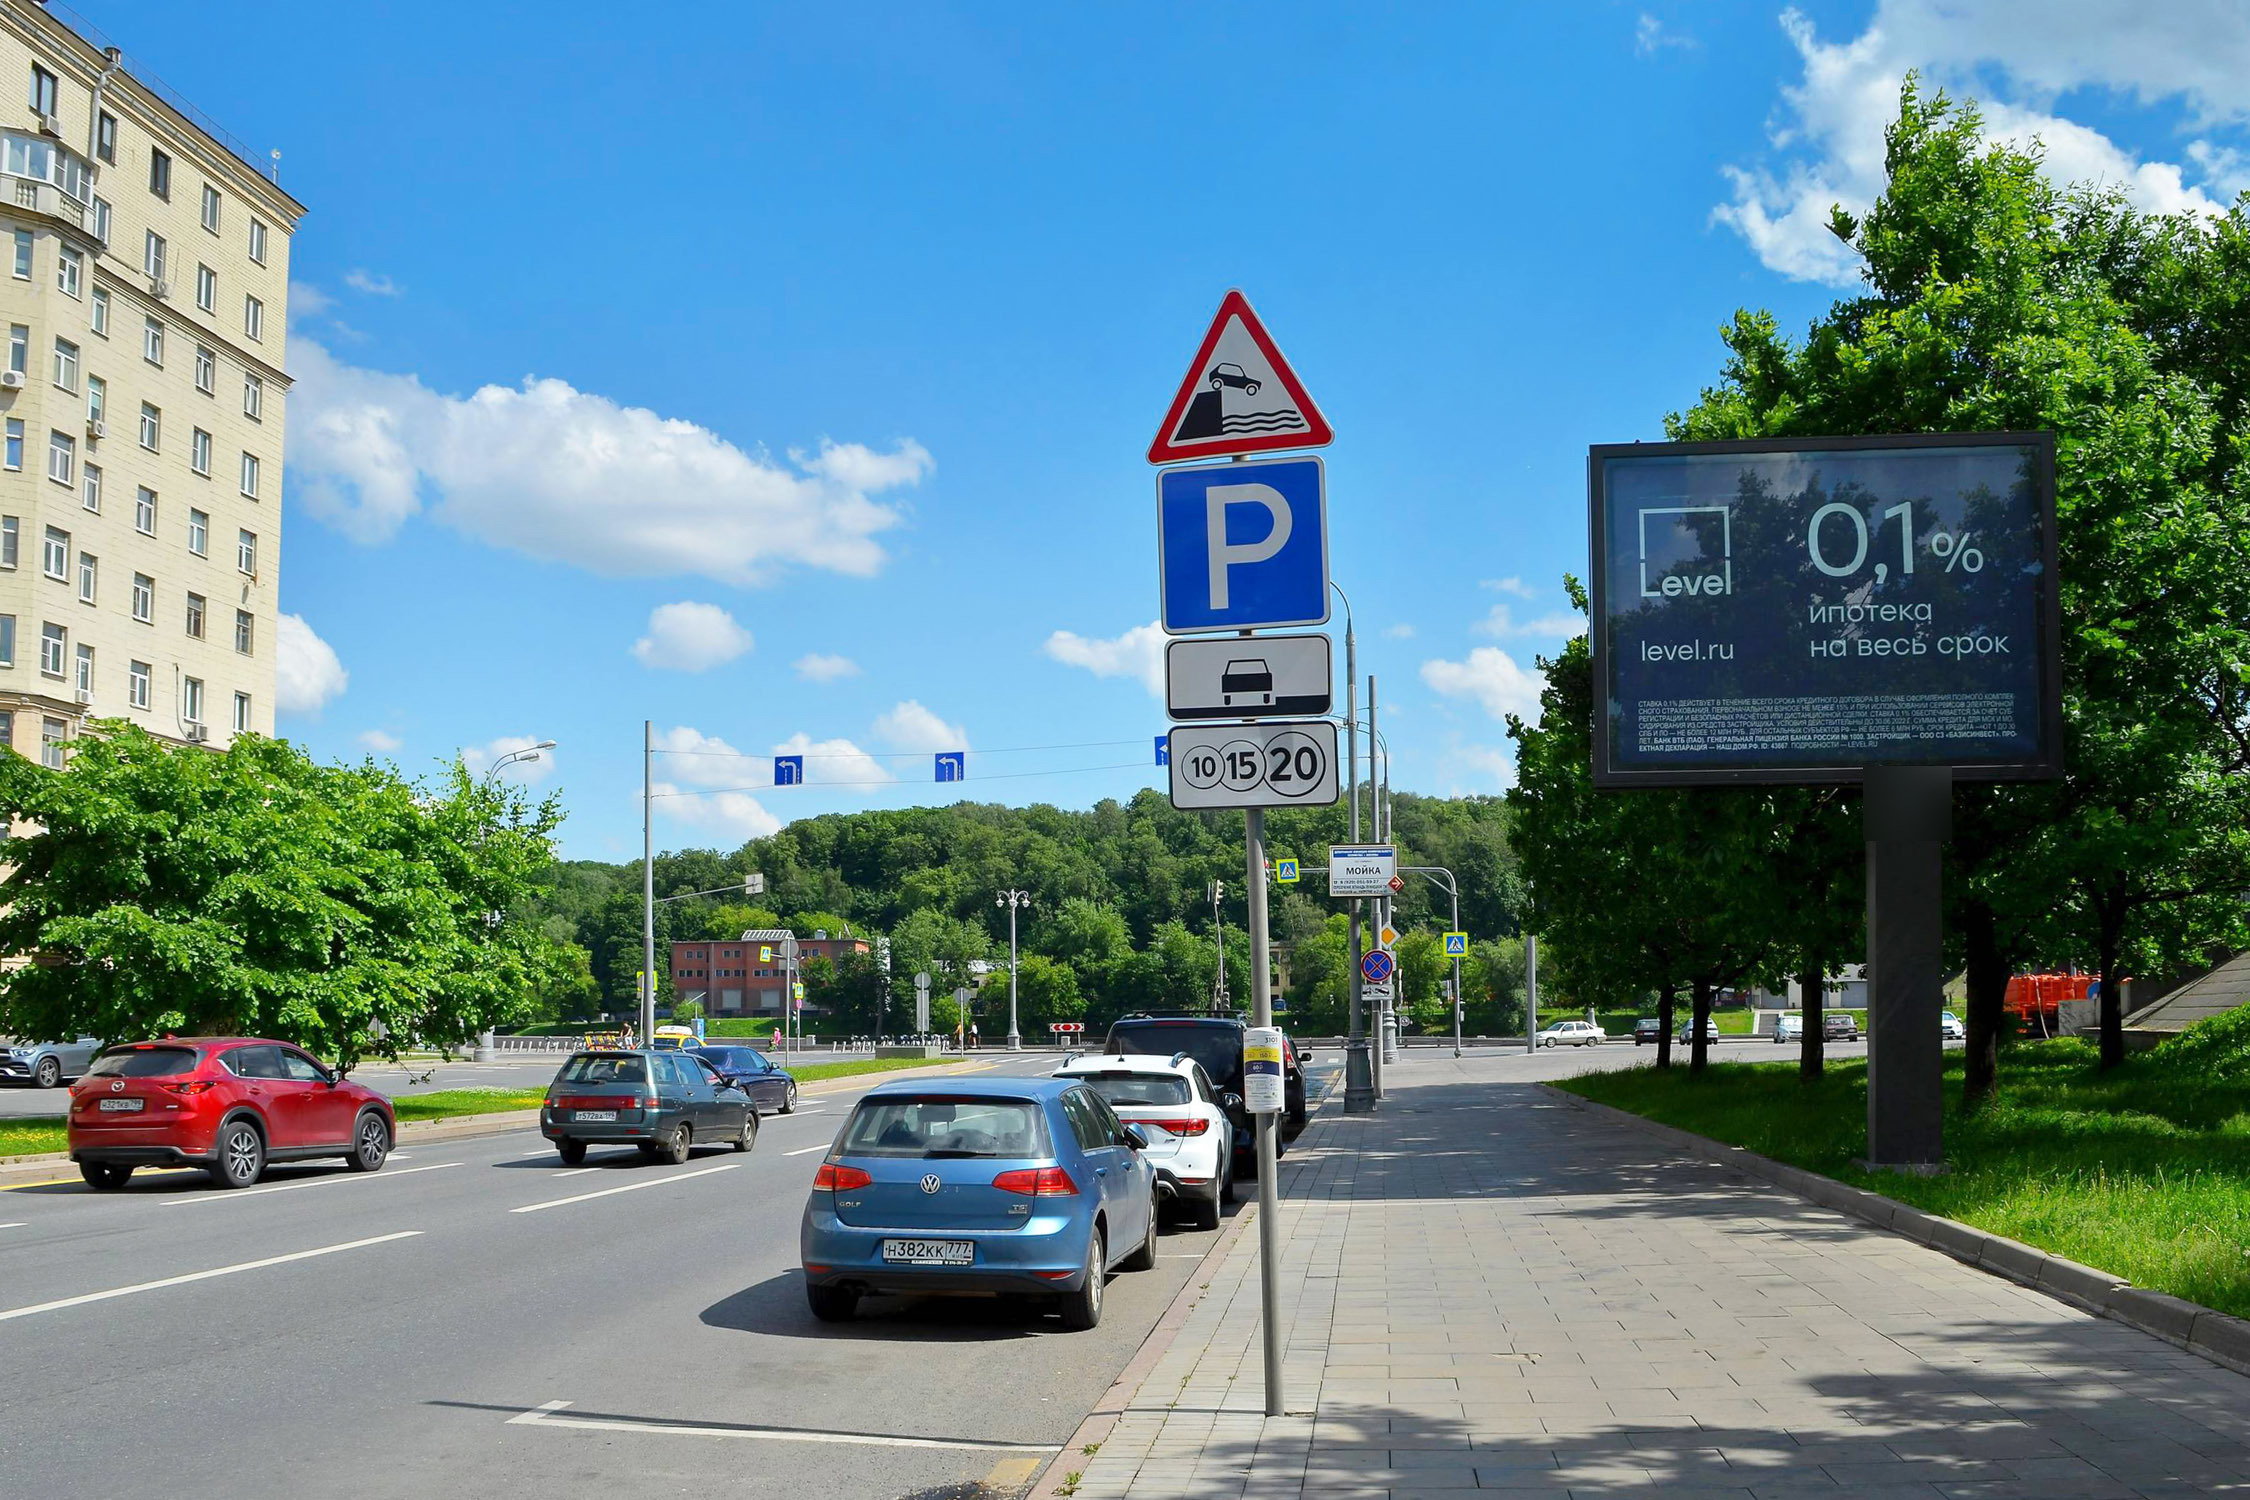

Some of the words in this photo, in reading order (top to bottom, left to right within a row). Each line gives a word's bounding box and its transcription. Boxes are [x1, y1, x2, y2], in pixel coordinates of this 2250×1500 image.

[1206, 483, 1293, 610] P
[1639, 562, 1732, 598] Level
[1809, 603, 1932, 625] ипотека
[1641, 640, 1735, 662] level.ru
[1811, 638, 1847, 657] на
[1858, 637, 1927, 656] весь
[1938, 635, 2010, 661] срок
[1796, 696, 1838, 704] КРЕДИТНОГО
[1706, 735, 1754, 743] ГЕНЕРАЛЬНАЯ
[1191, 757, 1216, 778] 10
[1226, 752, 1257, 780] 15
[1270, 746, 1317, 781] 20
[1346, 865, 1381, 875] МОЙКА
[888, 1242, 944, 1257] Н382КК
[948, 1243, 970, 1254] 777
